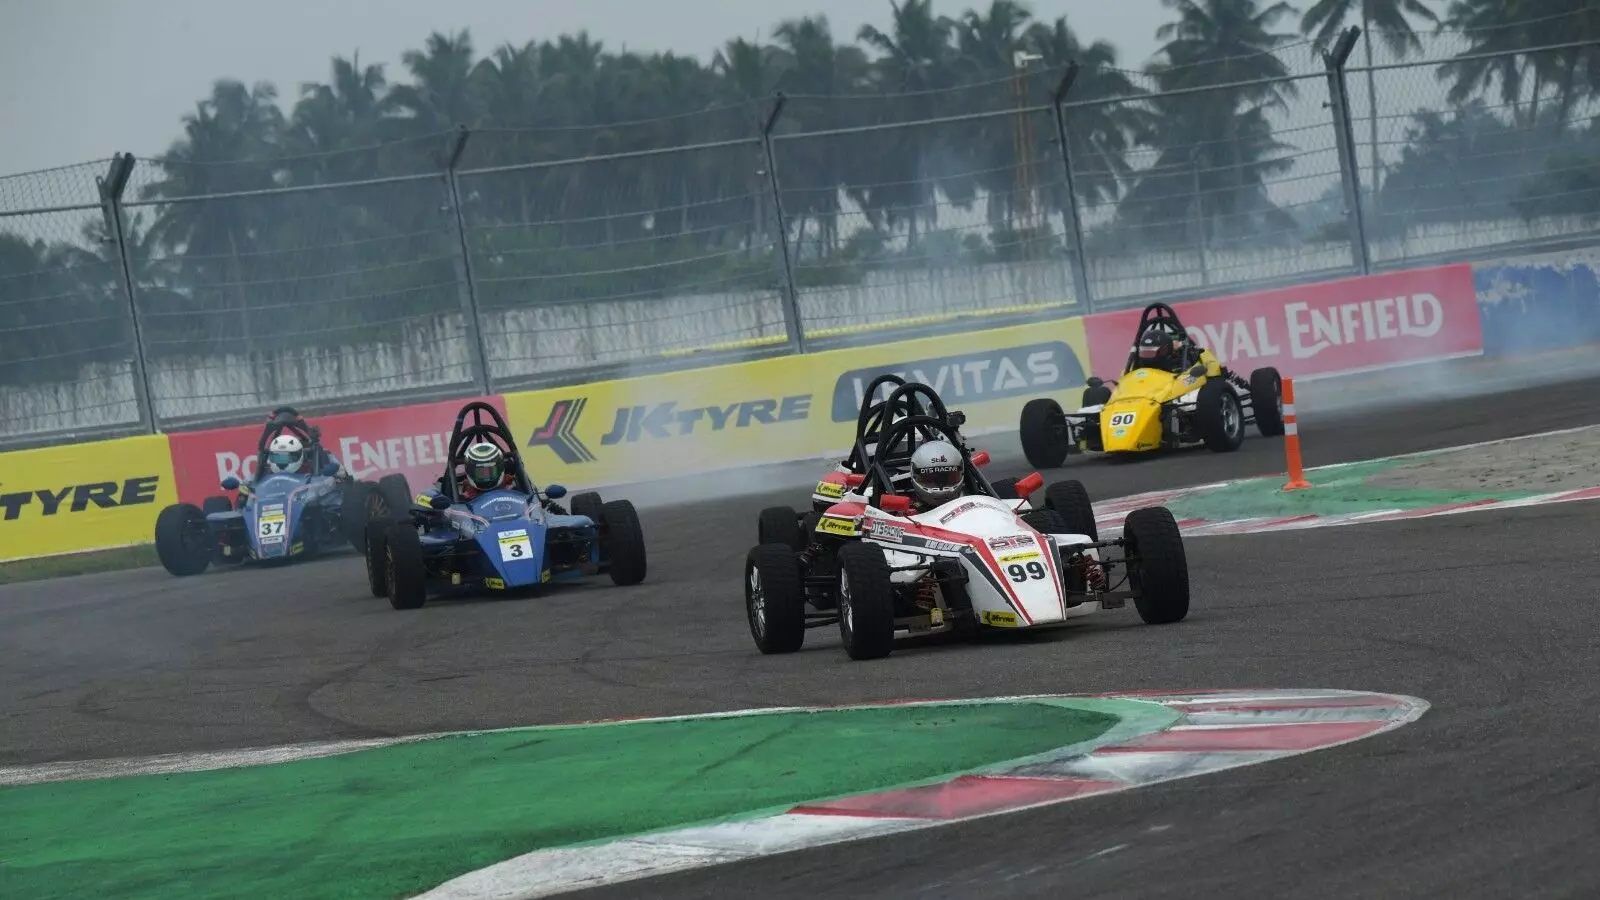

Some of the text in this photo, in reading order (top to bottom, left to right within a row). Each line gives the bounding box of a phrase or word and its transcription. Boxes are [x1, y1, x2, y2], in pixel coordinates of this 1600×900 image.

[1184, 293, 1444, 363] OYAL ENFIELD
[1111, 414, 1134, 426] 90
[339, 430, 453, 483] ENFIEL
[0, 475, 160, 521] TYRE
[261, 521, 284, 536] 37
[509, 544, 524, 558] 3
[1007, 561, 1046, 583] 99
